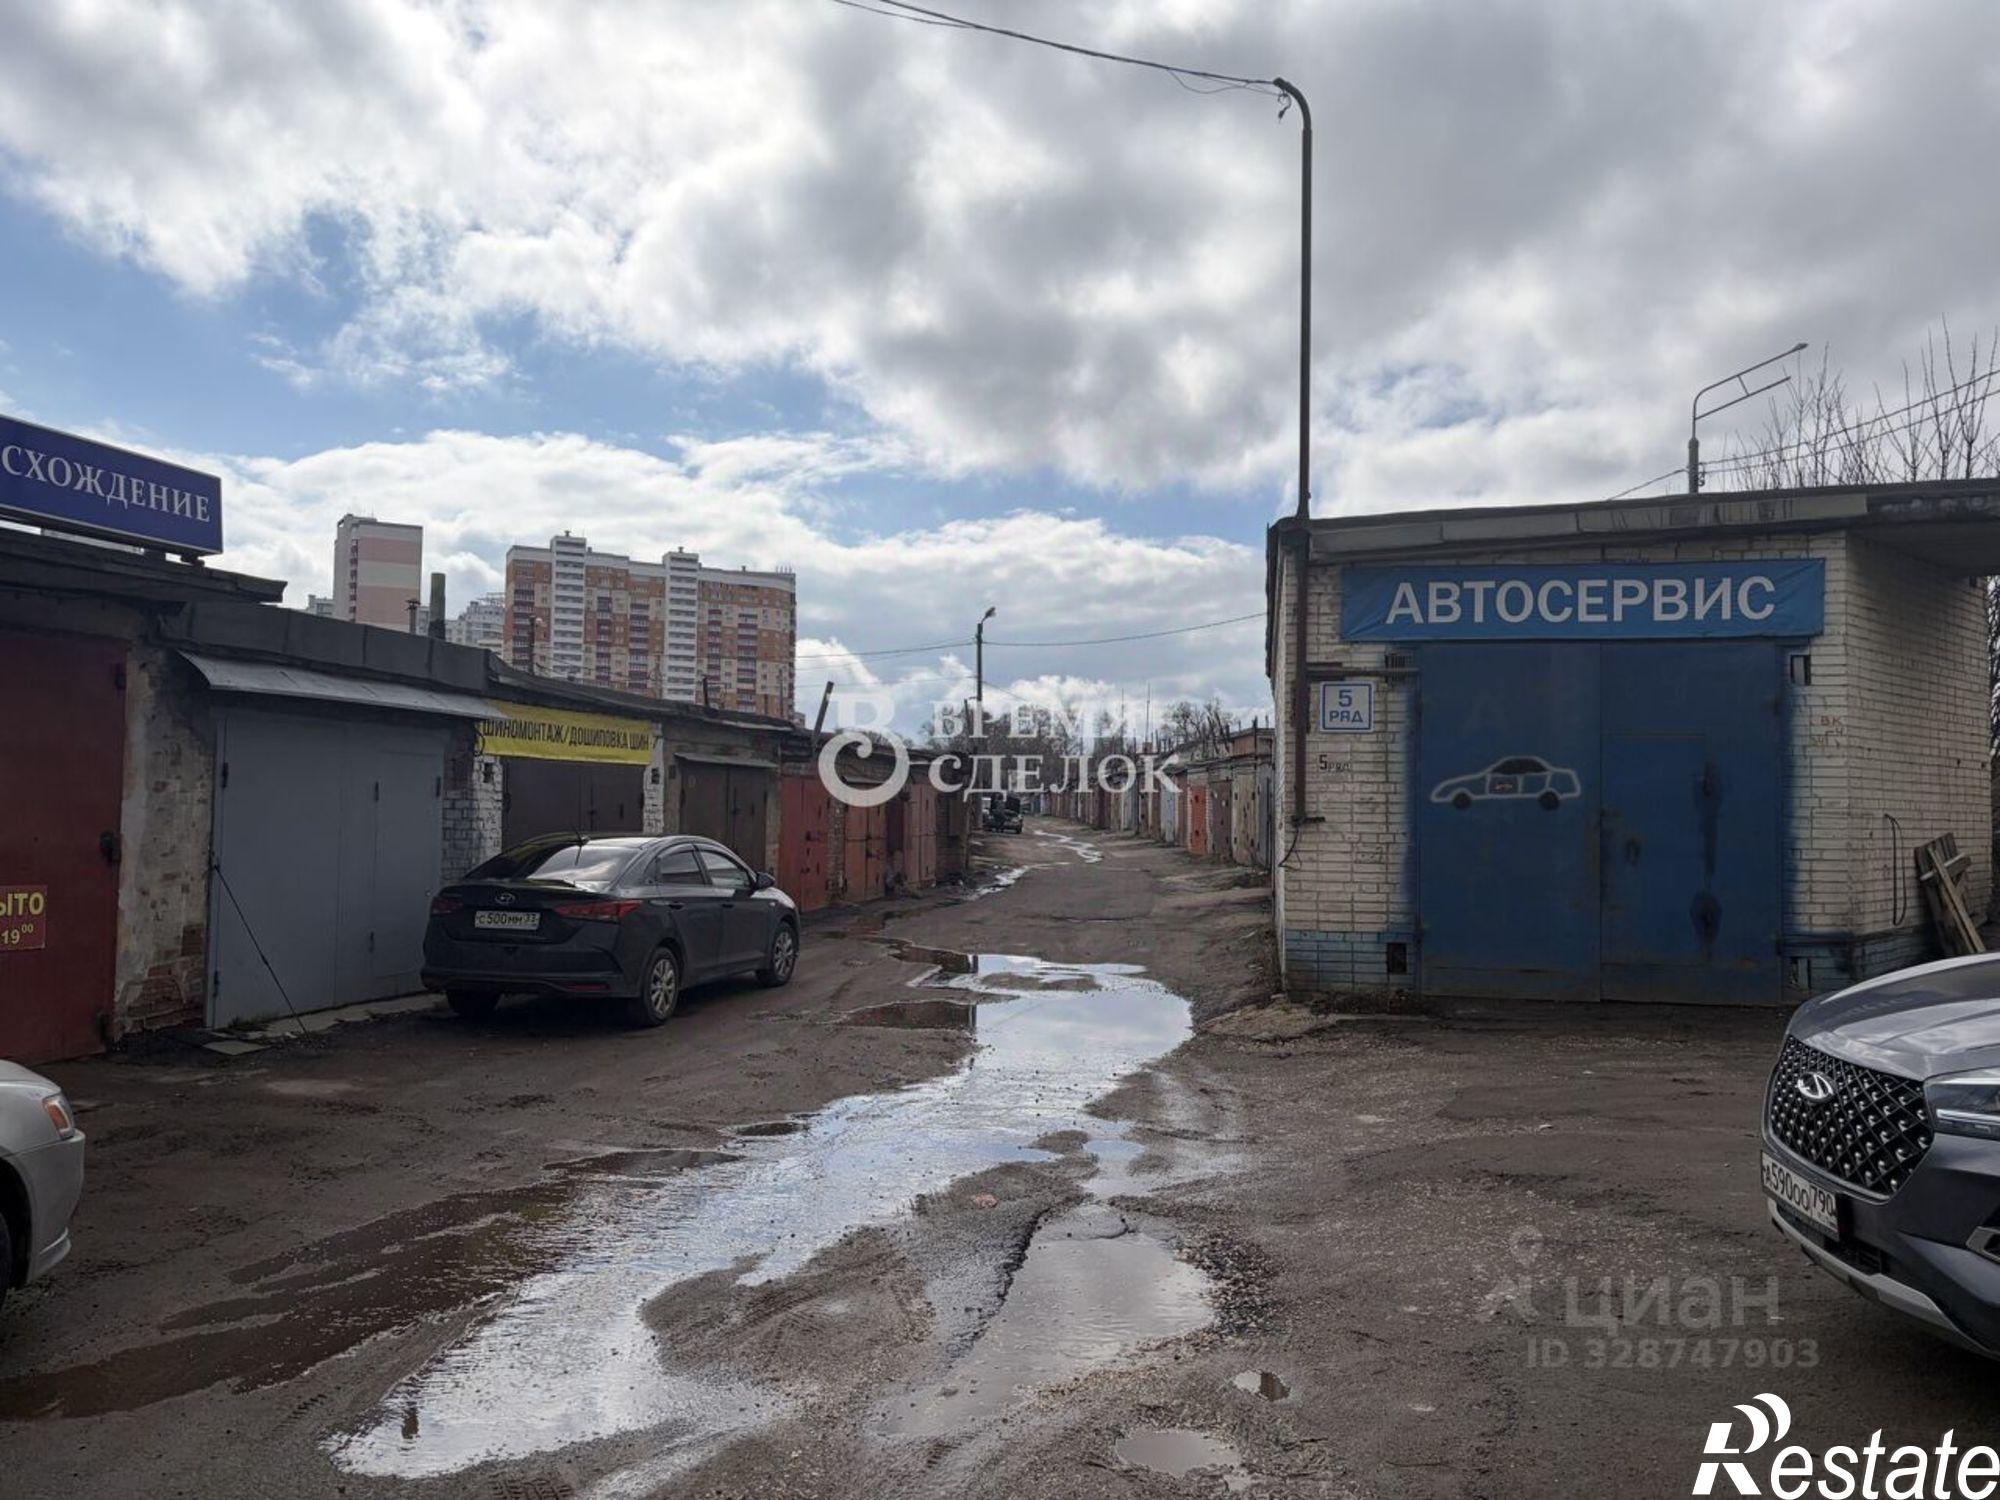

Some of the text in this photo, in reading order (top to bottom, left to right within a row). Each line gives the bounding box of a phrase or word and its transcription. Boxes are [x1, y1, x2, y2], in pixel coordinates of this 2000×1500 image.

[2, 445, 210, 523] СХОЖДЕНИЕ
[1385, 575, 1777, 625] АВТОСЕРВИС
[1338, 689, 1352, 707] 5
[1329, 710, 1364, 723] РЯД
